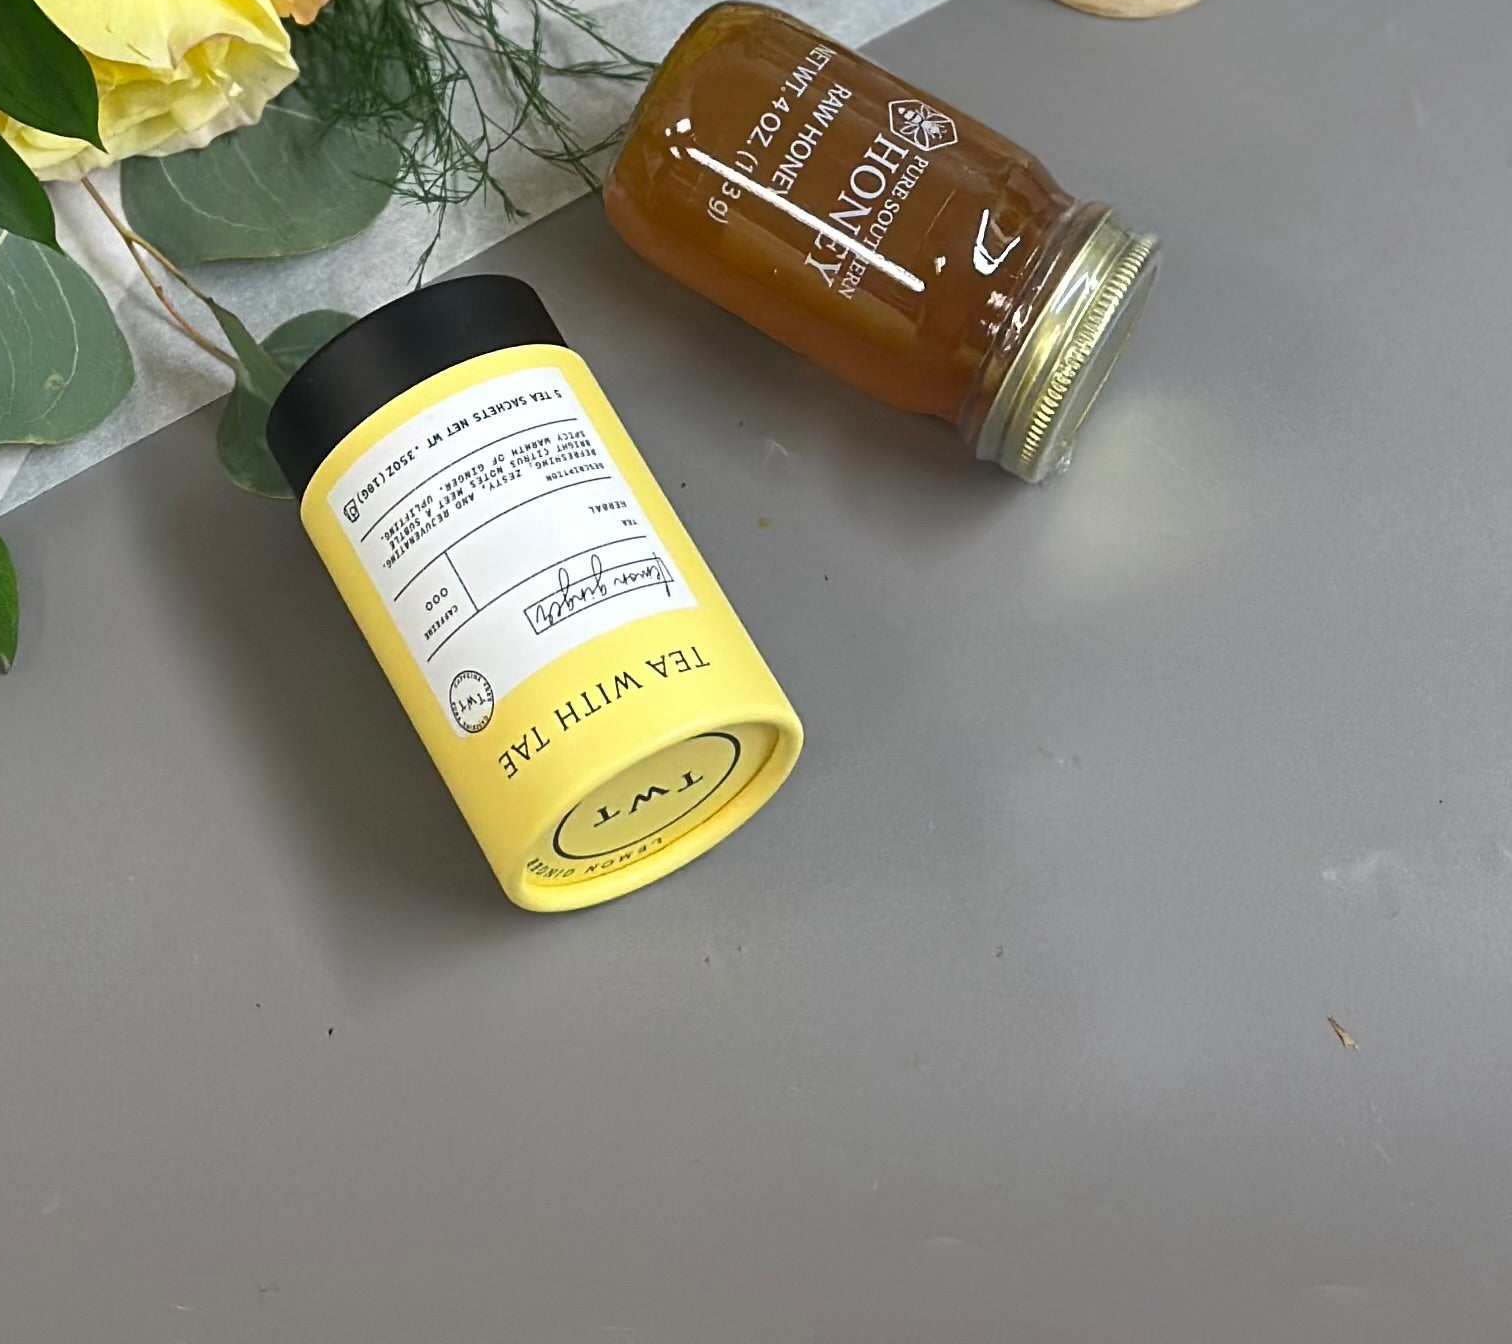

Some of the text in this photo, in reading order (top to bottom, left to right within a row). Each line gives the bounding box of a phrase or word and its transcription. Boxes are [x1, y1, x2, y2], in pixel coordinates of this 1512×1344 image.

[805, 44, 837, 71] NET
[771, 97, 790, 113] 4
[812, 82, 853, 129] RAW
[746, 112, 782, 148] OZ.
[838, 155, 930, 300] PURE SOUTERN
[529, 390, 552, 403] TEA
[554, 389, 562, 399] 5
[472, 396, 527, 422] SACHETS
[446, 418, 469, 437] NET
[426, 433, 444, 449] WT
[511, 437, 551, 456] WARMTH
[492, 454, 505, 466] OF
[439, 463, 485, 492] GINGER.
[482, 469, 522, 491] ZESTY,
[546, 462, 604, 481] DESCRIPTION
[389, 439, 591, 550] BRIGHT CITRUS NOTES MEET A SUBTLE
[455, 492, 475, 510] AND
[588, 500, 627, 514] HERBAL
[380, 495, 433, 541] UPLIFTING.
[620, 519, 637, 527] TEA
[458, 693, 486, 712] TWT
[498, 646, 710, 779] TEA WITH TAE
[593, 770, 704, 828] TWT
[585, 837, 663, 874] LEMON
